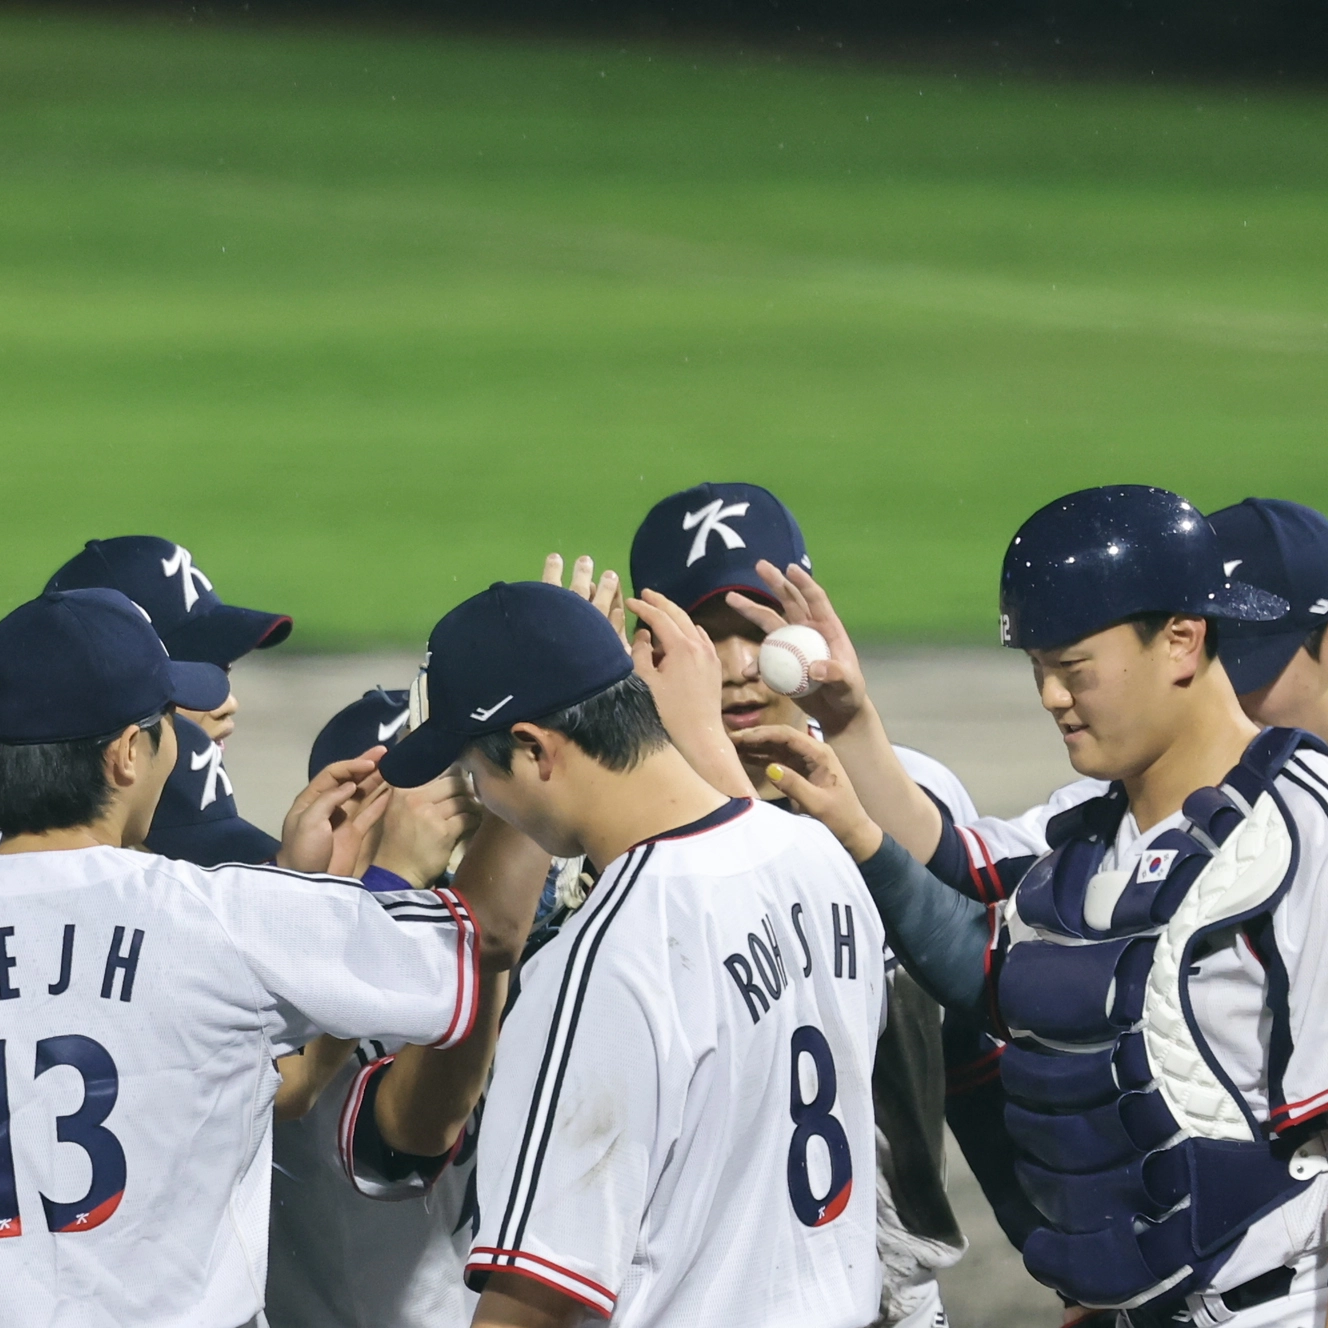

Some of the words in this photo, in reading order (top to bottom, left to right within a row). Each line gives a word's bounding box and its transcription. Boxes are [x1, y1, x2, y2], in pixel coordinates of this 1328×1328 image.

[682, 498, 750, 567] K
[48, 924, 76, 996] J
[100, 925, 145, 1002] H
[723, 913, 788, 1025] ROH
[831, 903, 857, 980] H
[787, 1025, 853, 1228] 8
